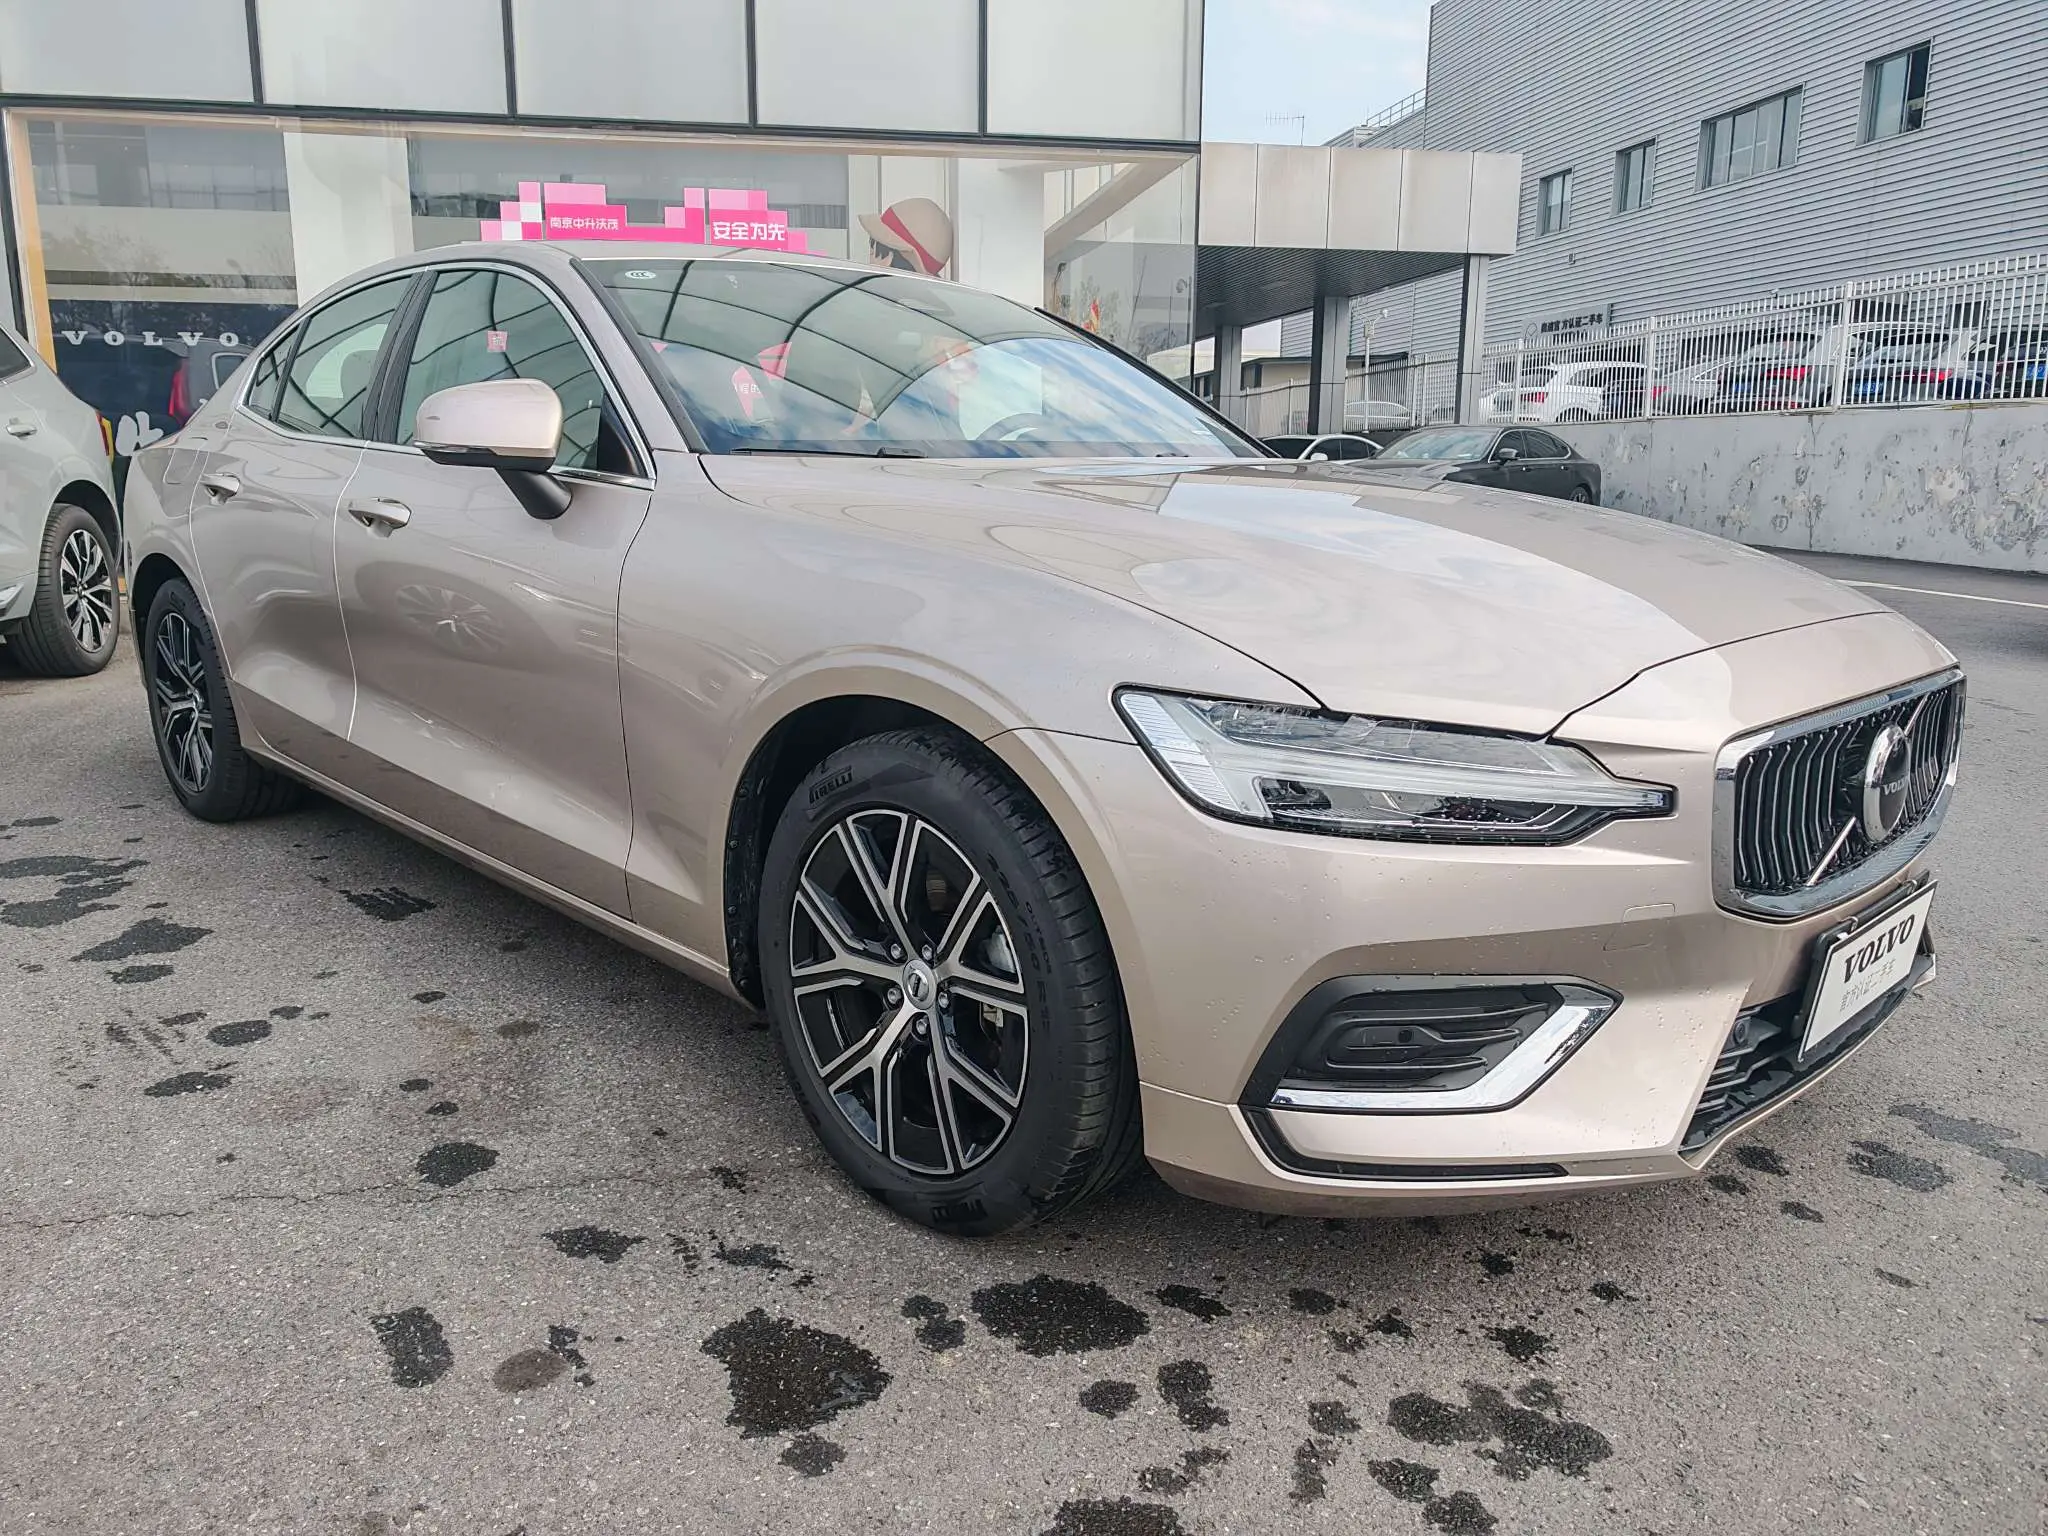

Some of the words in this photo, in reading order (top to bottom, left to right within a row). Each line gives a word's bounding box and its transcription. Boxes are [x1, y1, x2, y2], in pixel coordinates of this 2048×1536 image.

[550, 216, 619, 231] 南京中升沃茂
[712, 221, 785, 241] 安全为先
[61, 330, 239, 347] VOLVO
[1843, 914, 1915, 983] VOLVO
